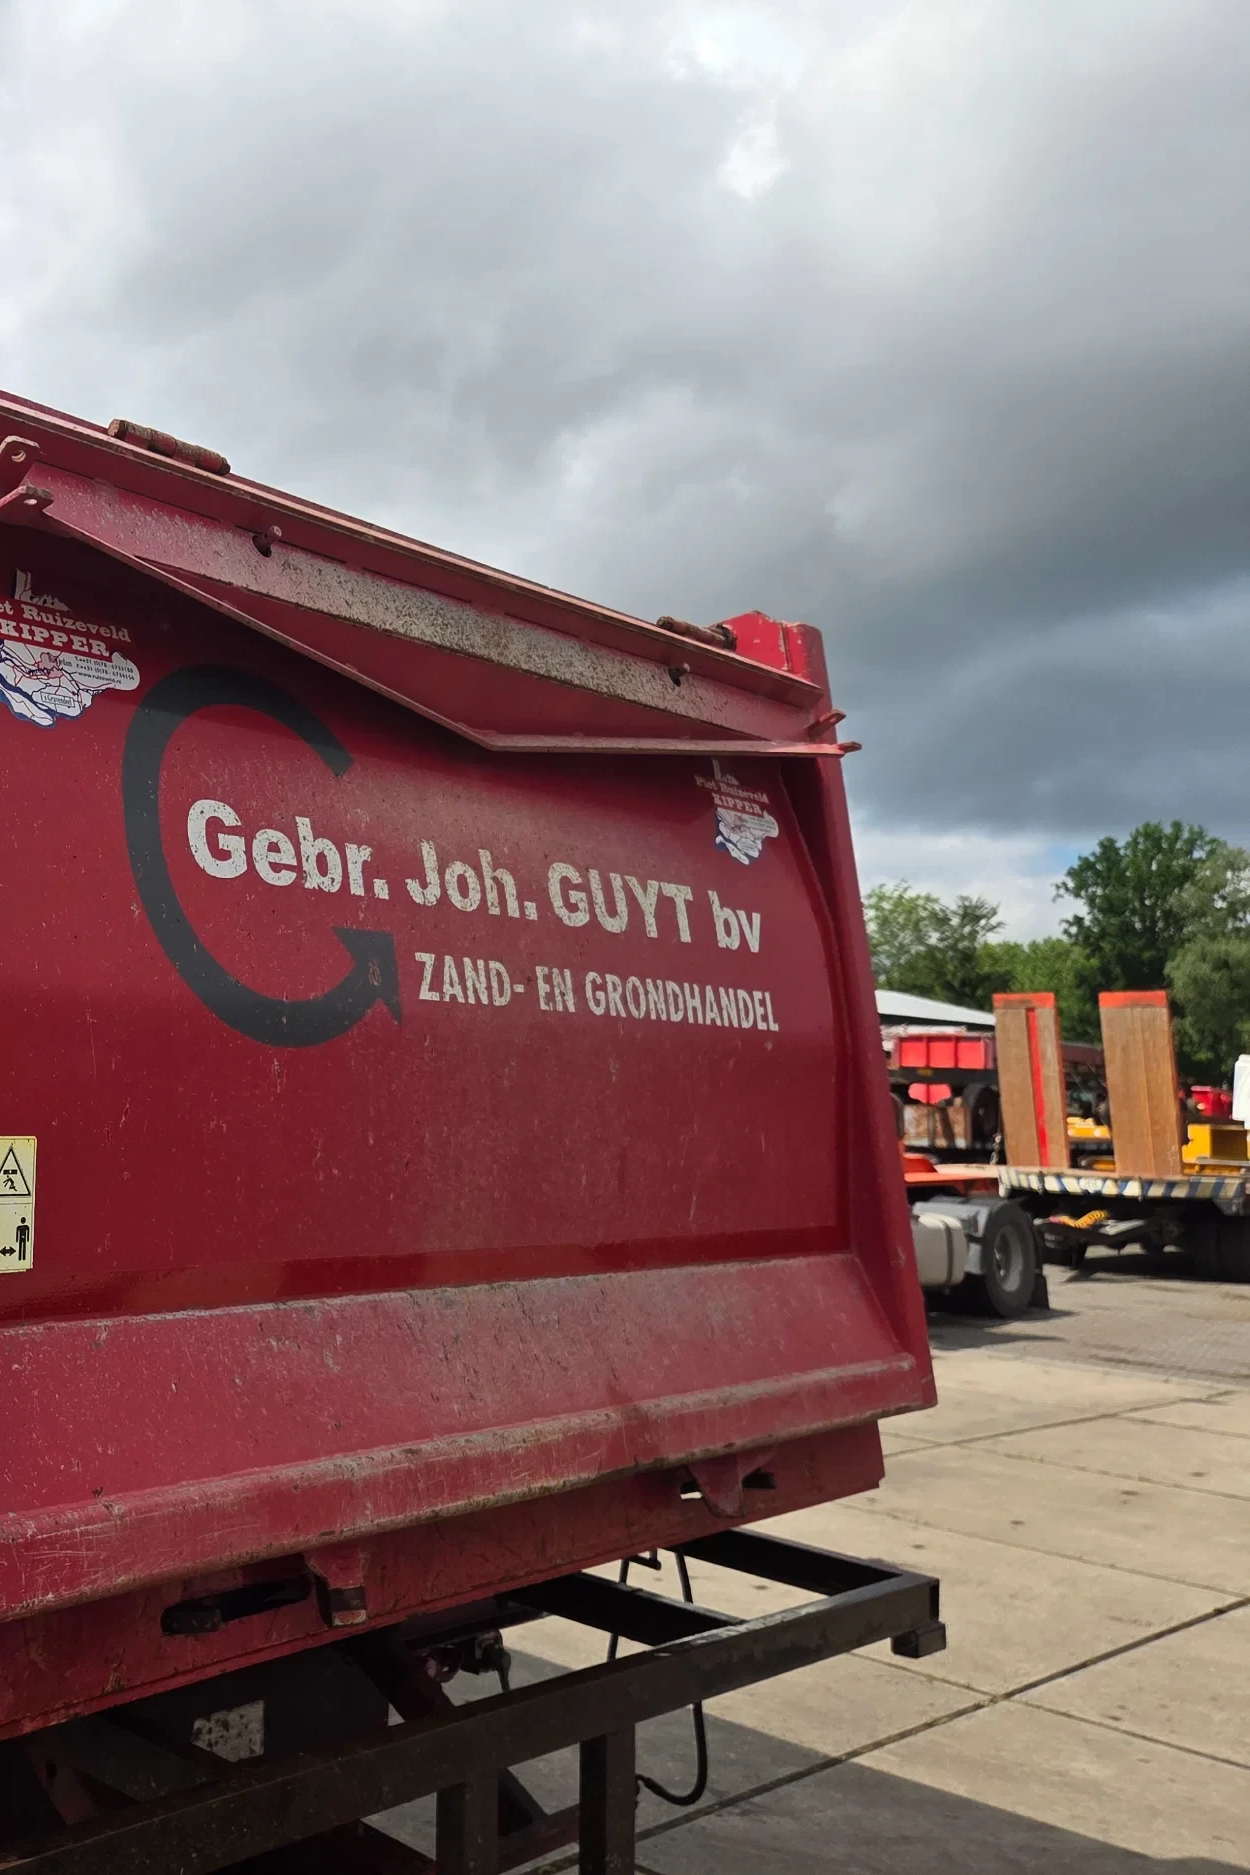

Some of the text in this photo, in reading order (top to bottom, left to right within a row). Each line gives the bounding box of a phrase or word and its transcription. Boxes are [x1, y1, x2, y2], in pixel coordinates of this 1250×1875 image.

[21, 603, 132, 643] Ruizeveld
[711, 792, 763, 815] KIPPER
[187, 799, 762, 954] Gebr. Joh. GUYT bv
[414, 951, 780, 1032] ZAND- EN GRONDHANDEL
